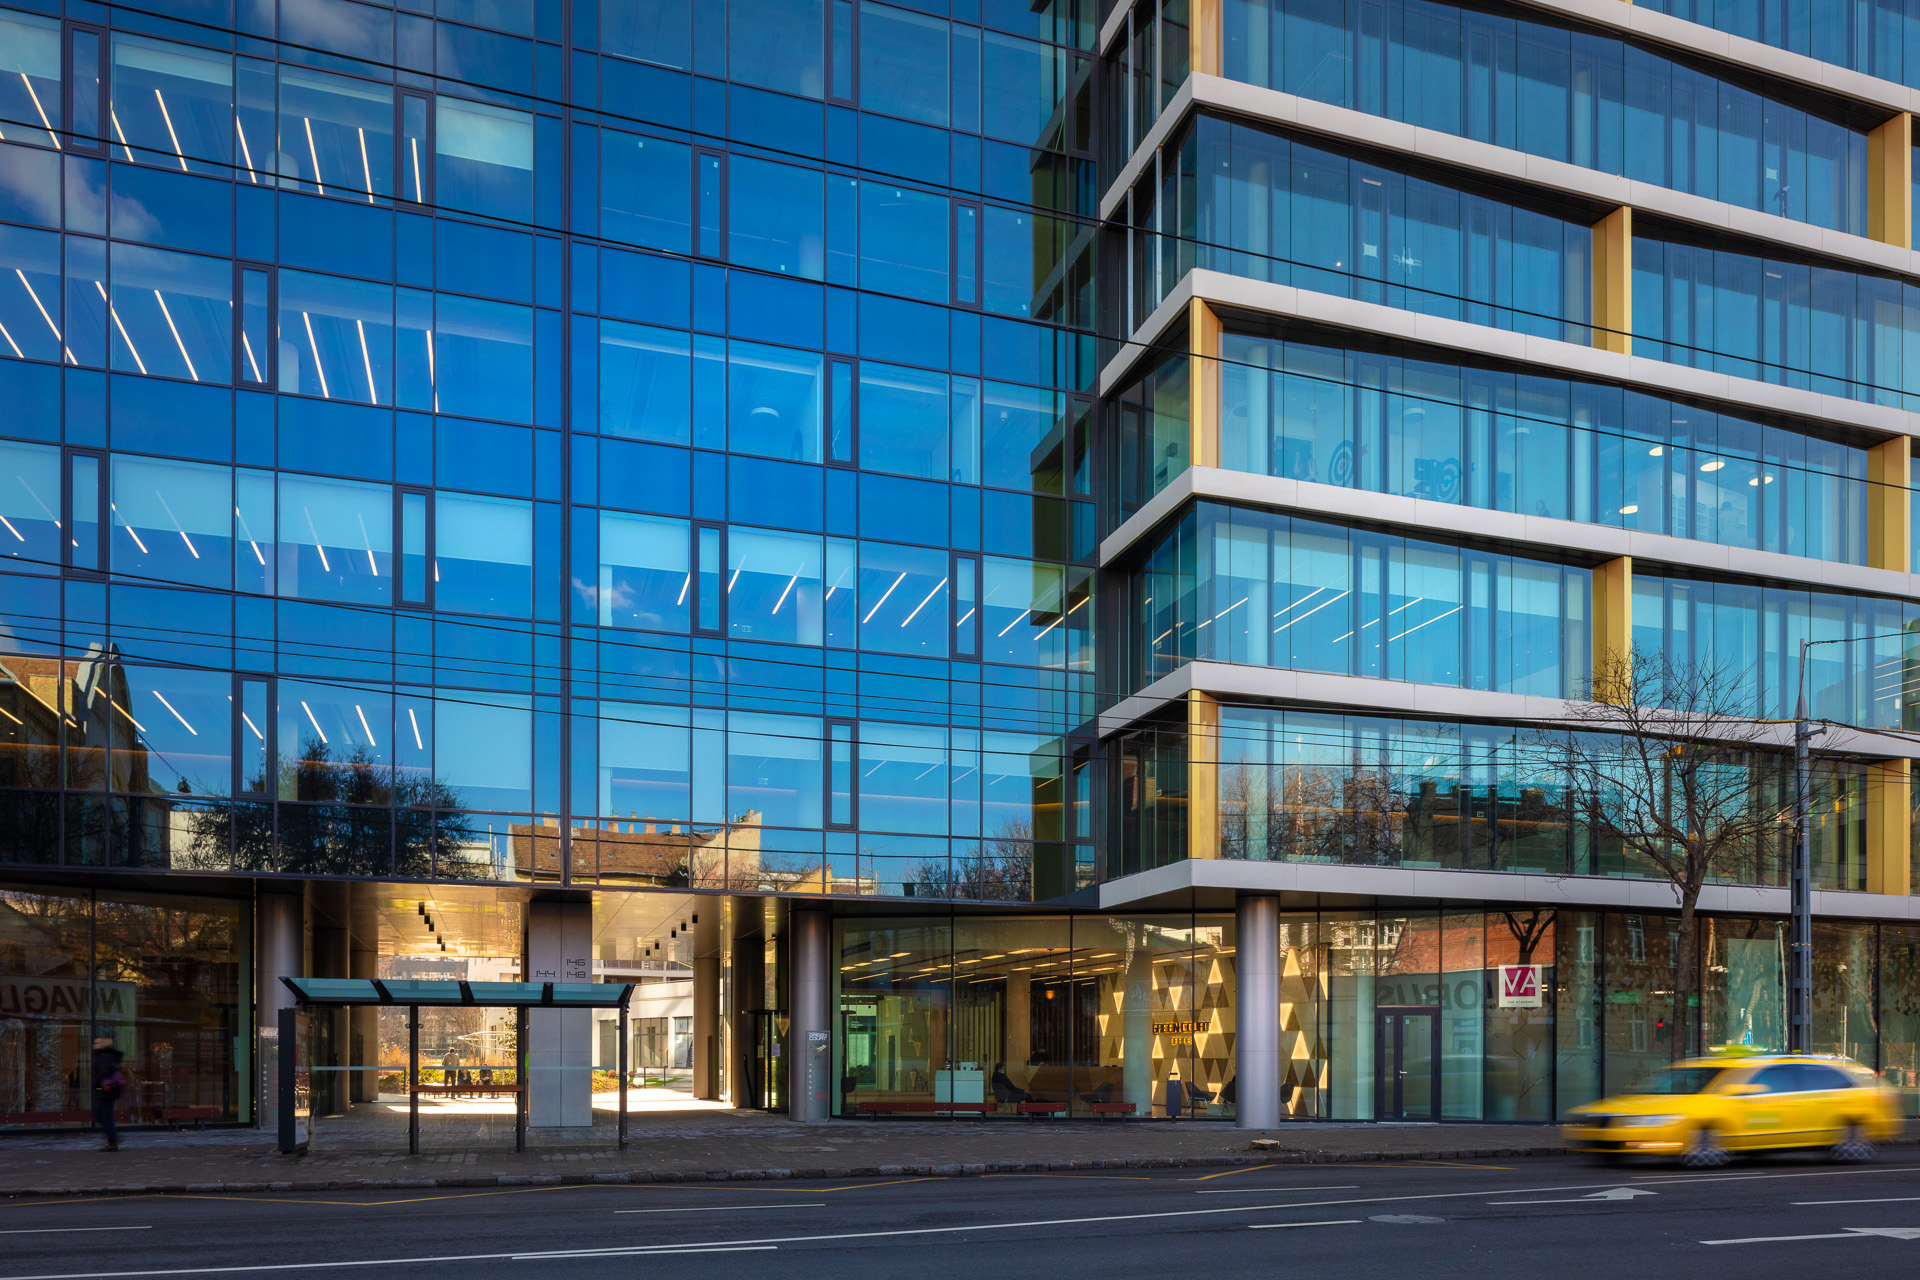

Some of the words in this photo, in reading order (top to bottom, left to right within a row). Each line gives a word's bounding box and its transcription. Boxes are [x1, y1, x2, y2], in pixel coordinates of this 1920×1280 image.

[566, 958, 586, 966] 146
[566, 970, 586, 978] 148
[1504, 968, 1536, 994] VA
[1153, 1022, 1180, 1034] GREEN
[1181, 1021, 1212, 1033] COURT
